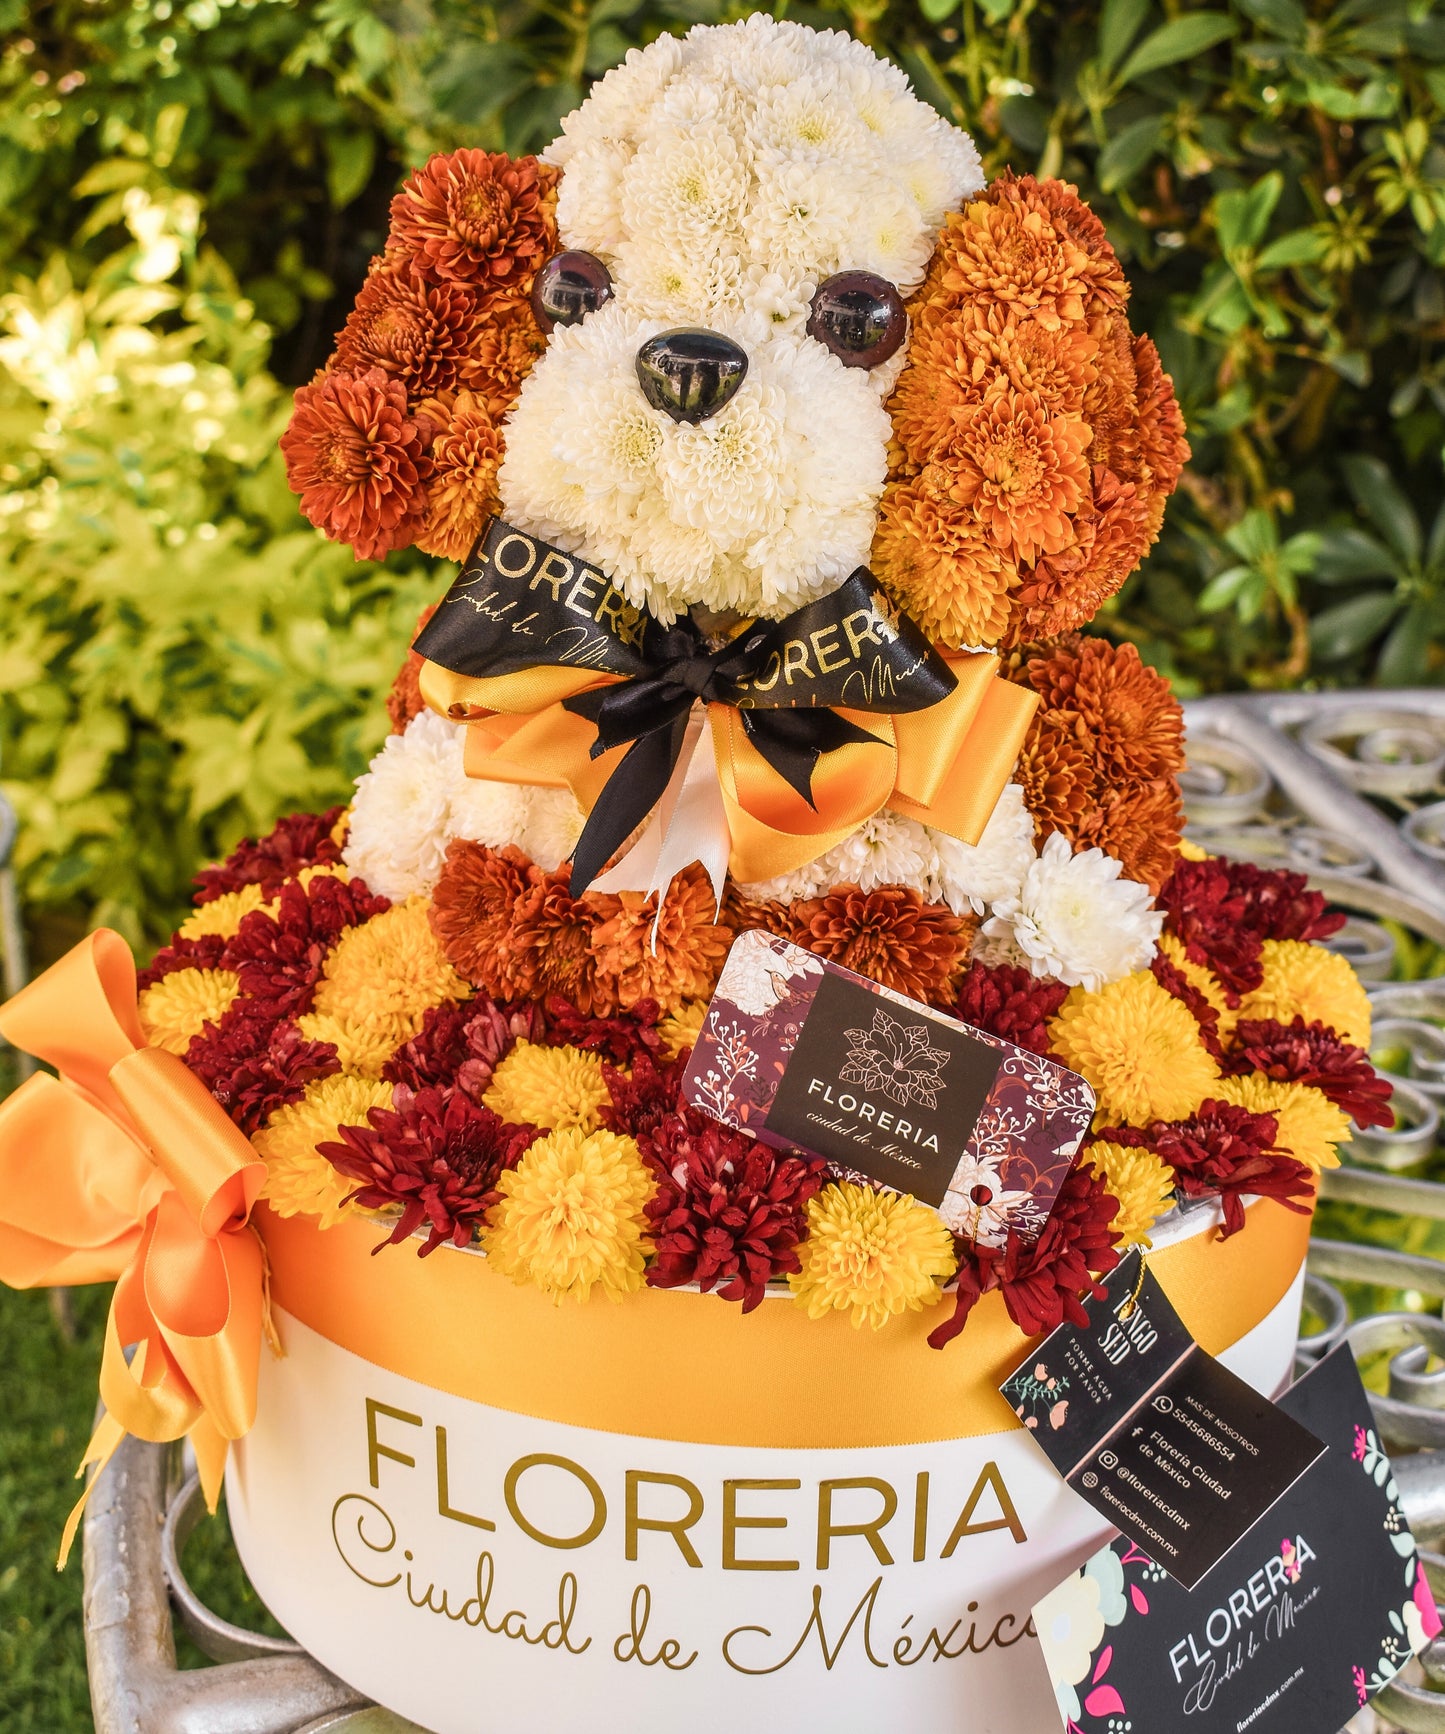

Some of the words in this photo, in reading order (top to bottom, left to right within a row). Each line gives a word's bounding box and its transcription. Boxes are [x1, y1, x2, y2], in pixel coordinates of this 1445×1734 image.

[806, 1111, 858, 1137] ciudad
[852, 1132, 873, 1145] de
[807, 1078, 939, 1154] FLORERIA
[1097, 1322, 1131, 1365] SED
[1112, 1288, 1158, 1355] TNGO
[1064, 1351, 1079, 1372] POR
[1078, 1372, 1102, 1404] FAVOR
[1068, 1337, 1095, 1373] PONME
[1093, 1375, 1113, 1401] AGUA
[1150, 1430, 1191, 1468] Florería
[1191, 1464, 1232, 1500] Ciudad
[1172, 1408, 1236, 1462] 5545686554
[1203, 1408, 1216, 1421] DE
[1214, 1417, 1260, 1457] NOSOTROS
[364, 1396, 1028, 1572] FLORERIA
[1116, 1466, 1191, 1531] @floreriacdmx
[1138, 1443, 1154, 1458] de
[1153, 1455, 1192, 1489] México
[1100, 1485, 1180, 1557] floreriacdmx.com.mx
[332, 1492, 593, 1655] Ciudad
[613, 1583, 699, 1671] de
[1183, 1641, 1244, 1715] Ciudad
